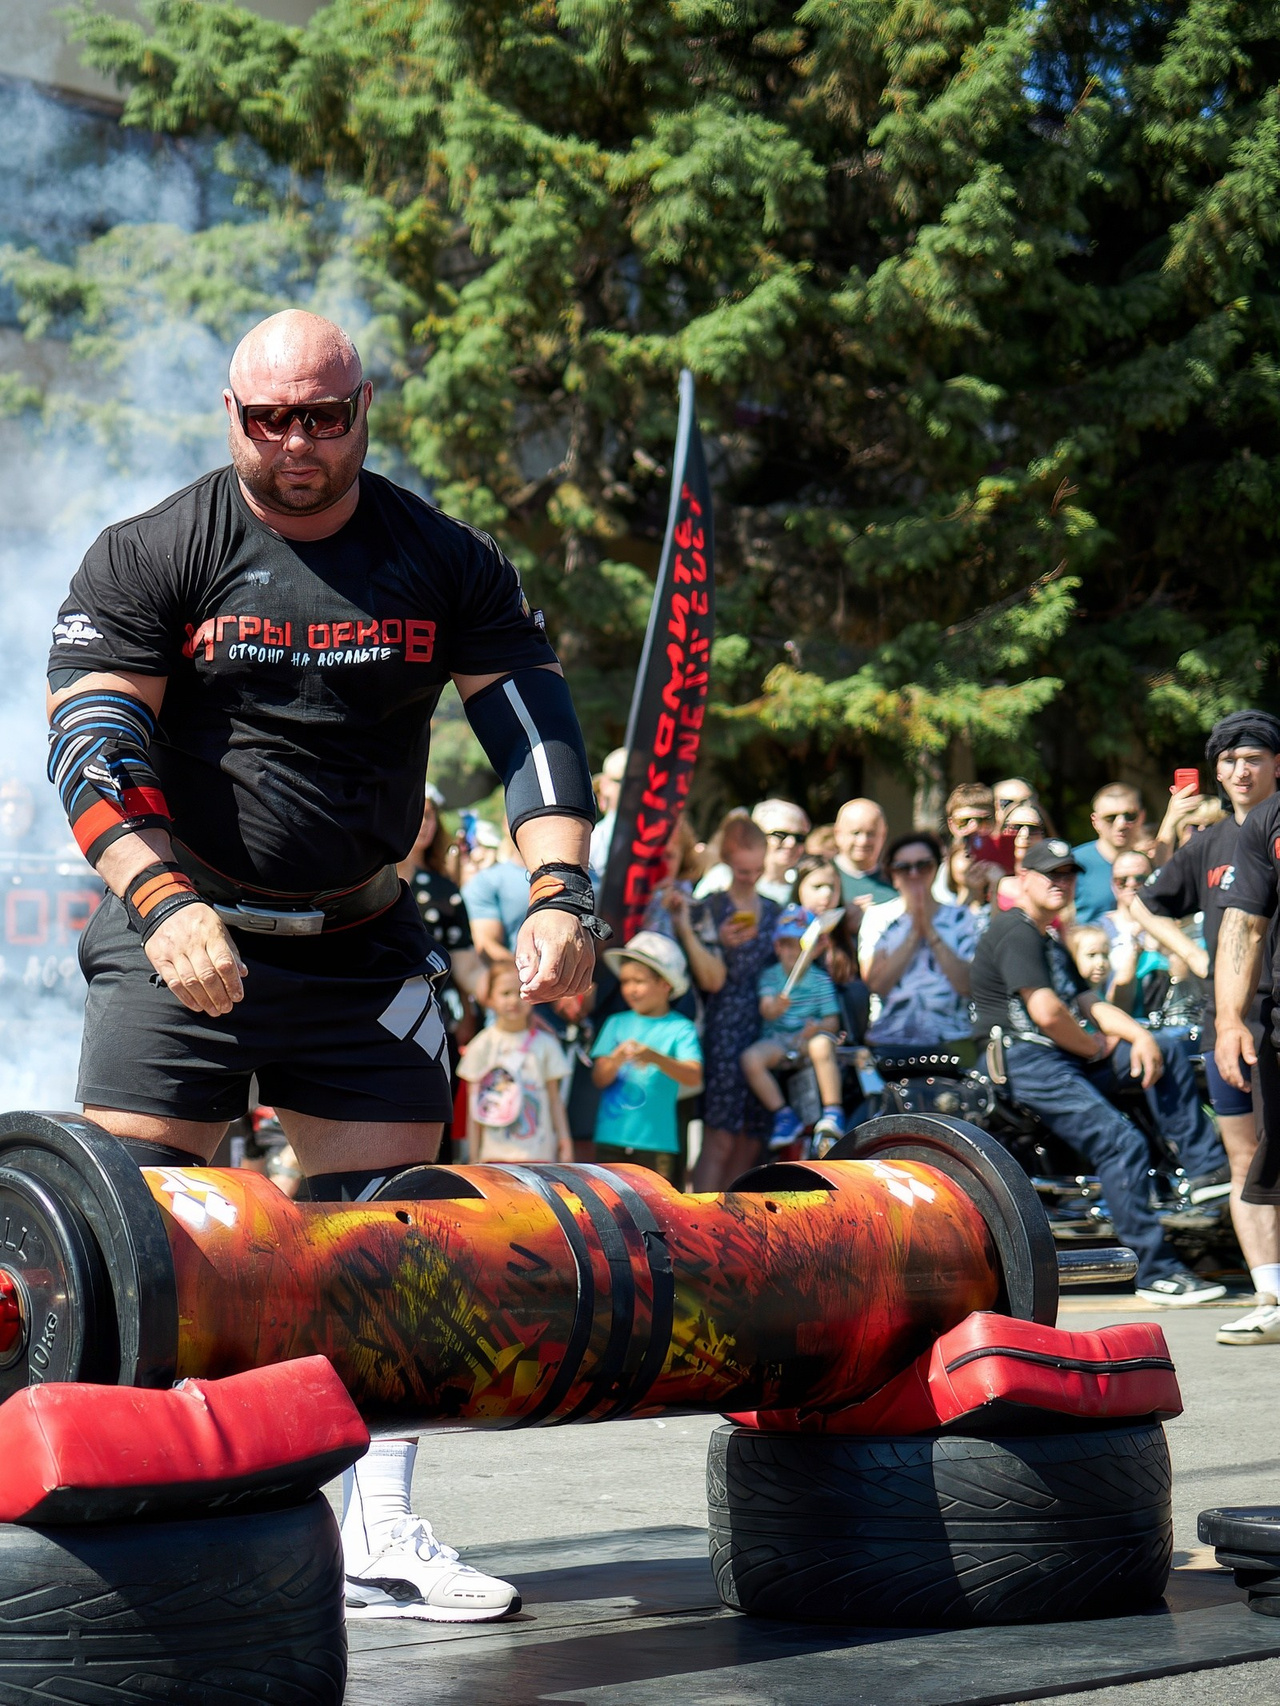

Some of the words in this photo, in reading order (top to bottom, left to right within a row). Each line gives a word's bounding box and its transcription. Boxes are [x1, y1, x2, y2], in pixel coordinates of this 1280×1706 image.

[182, 615, 292, 662] ИГРЫ
[308, 618, 437, 663] ОРКОВ
[228, 643, 284, 664] СТРОНГ
[291, 652, 311, 667] НА
[317, 646, 391, 667] АСФАЛЬТЕ
